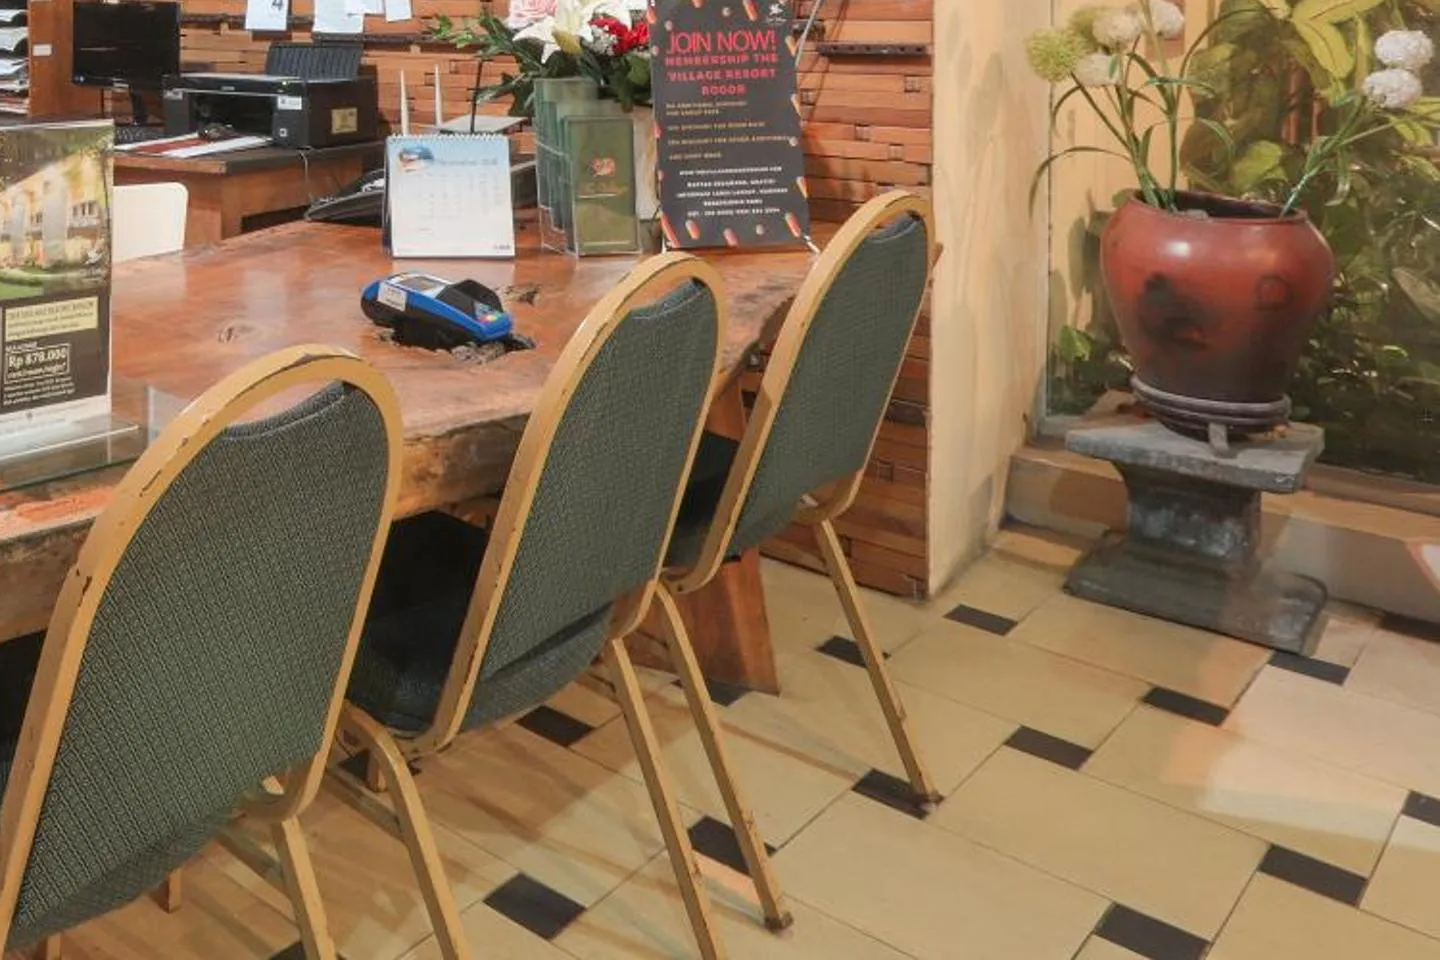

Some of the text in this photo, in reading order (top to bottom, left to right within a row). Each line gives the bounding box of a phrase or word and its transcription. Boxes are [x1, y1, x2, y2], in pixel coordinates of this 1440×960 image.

[667, 30, 777, 53] JOIN NOW!
[667, 71, 721, 82] VILLAGE
[9, 354, 24, 369] Rp
